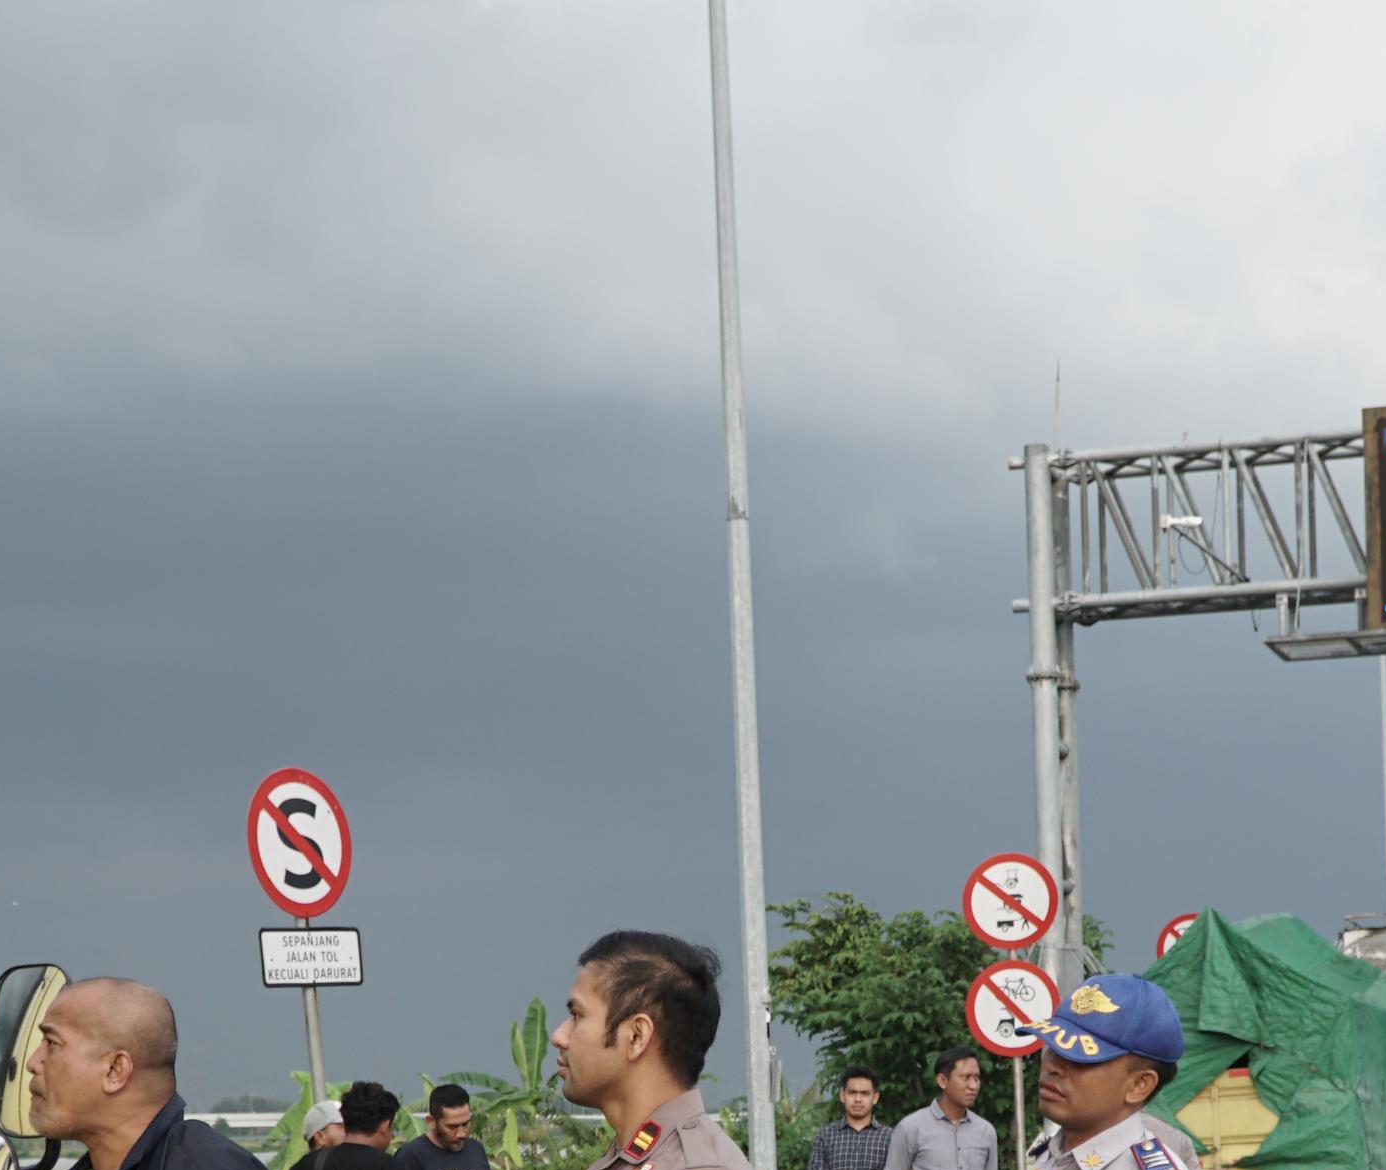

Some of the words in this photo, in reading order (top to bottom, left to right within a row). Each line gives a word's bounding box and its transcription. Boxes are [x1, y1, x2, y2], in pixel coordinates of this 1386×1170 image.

[282, 935, 339, 947] SEPANJANG
[286, 951, 316, 963] JALAN
[321, 951, 339, 962] TOL
[268, 968, 309, 980] KECUALI
[314, 967, 357, 979] DARURAT
